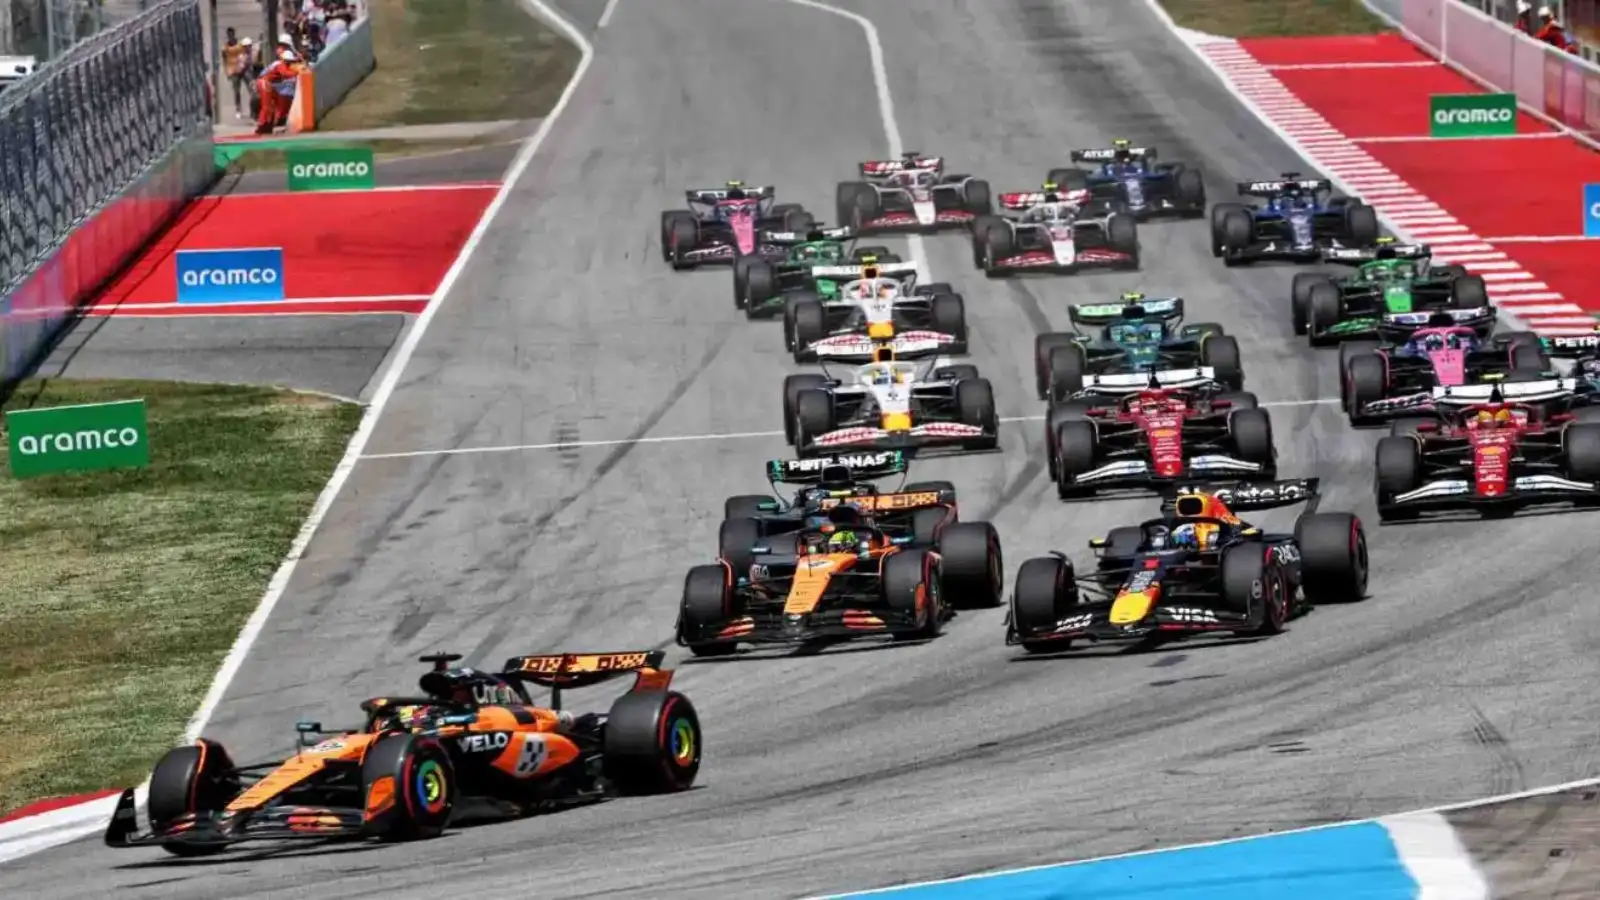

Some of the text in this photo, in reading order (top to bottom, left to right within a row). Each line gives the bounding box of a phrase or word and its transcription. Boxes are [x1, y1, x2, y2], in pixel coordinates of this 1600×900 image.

[1435, 108, 1512, 124] aramco
[292, 162, 369, 177] aramco
[1250, 180, 1319, 191] ATLAAN
[183, 268, 277, 286] aramco
[18, 427, 138, 455] aramco
[1164, 606, 1220, 623] VISA
[457, 732, 509, 753] VELO
